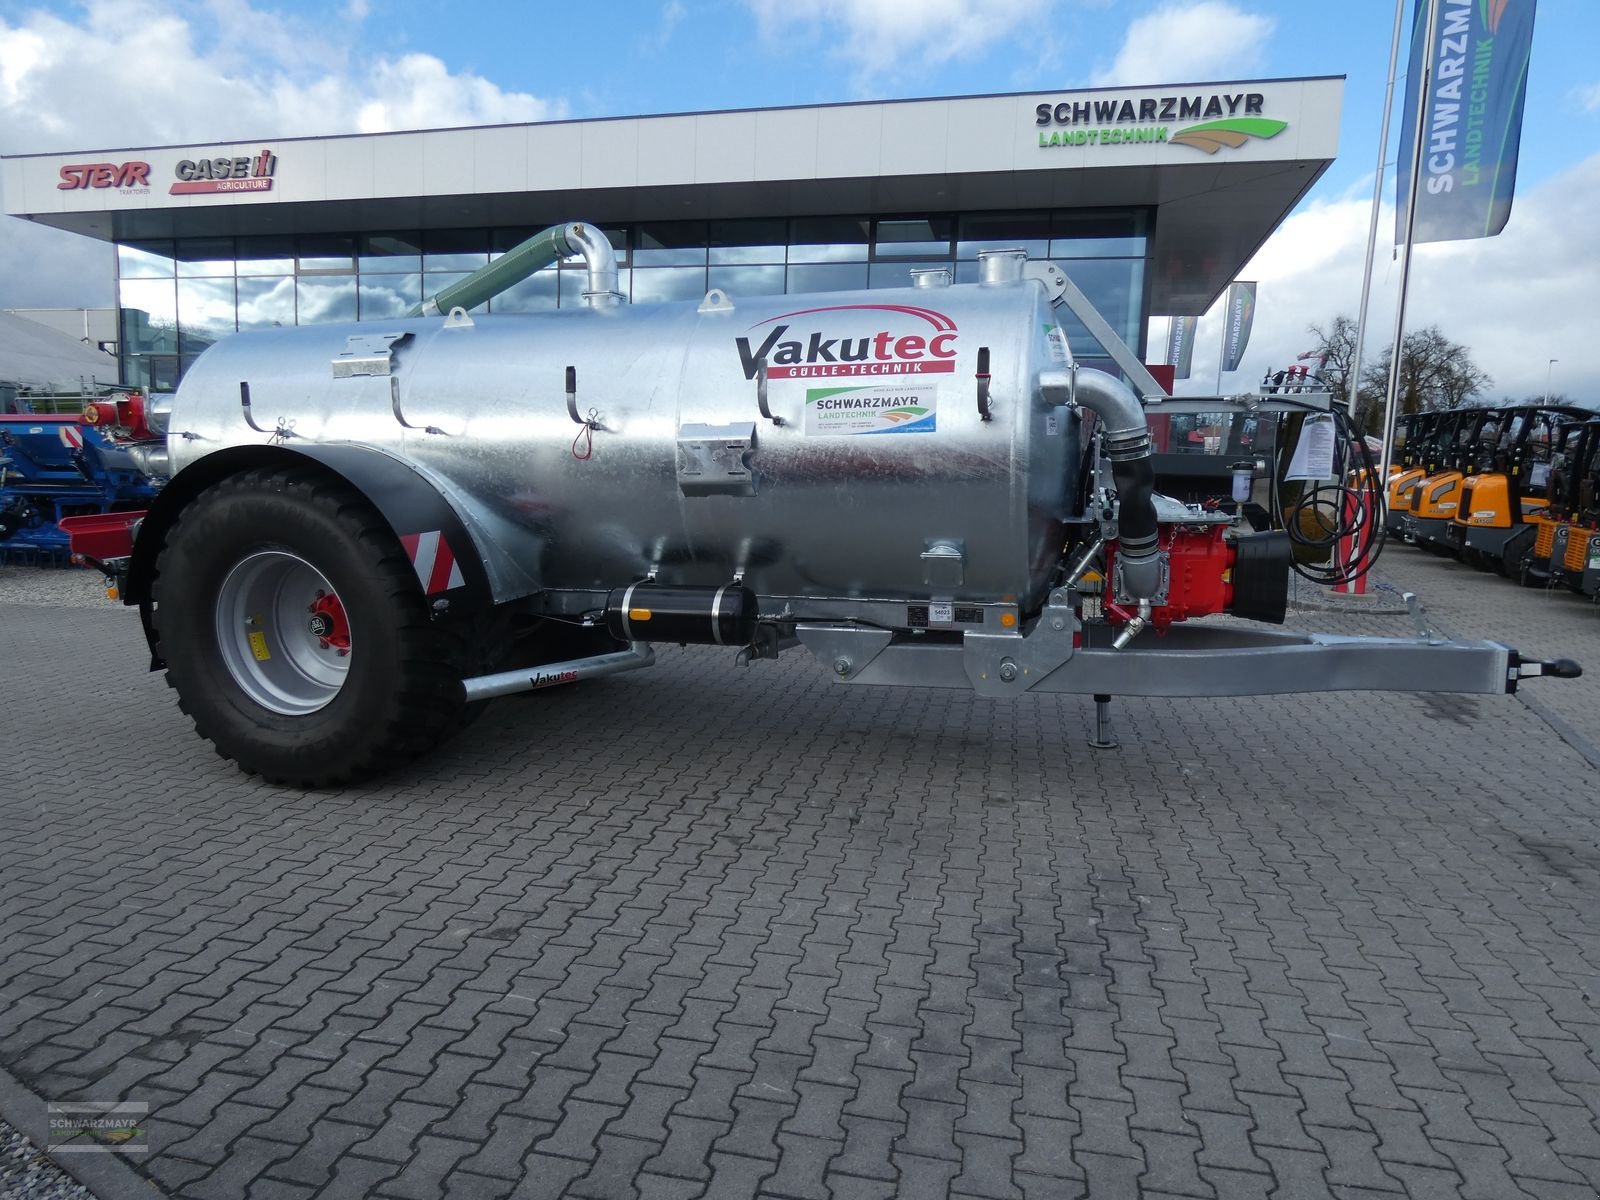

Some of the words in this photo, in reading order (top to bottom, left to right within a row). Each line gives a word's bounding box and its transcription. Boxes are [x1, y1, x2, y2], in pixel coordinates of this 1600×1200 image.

[1036, 93, 1264, 126] SCHWARZMAYR
[1462, 37, 1494, 186] LANDTECHNIK
[1039, 127, 1168, 147] LANDTECHNIK
[57, 161, 150, 190] STEYR
[175, 157, 249, 181] CASE
[216, 180, 268, 190] AGRICULTURE
[735, 325, 959, 380] Vakutec
[789, 362, 922, 377] GÜLLE-TECHNIK
[816, 396, 919, 410] SCHWARZMAYR
[818, 411, 877, 419] LANDTECHNIK
[529, 671, 578, 688] Vakutec
